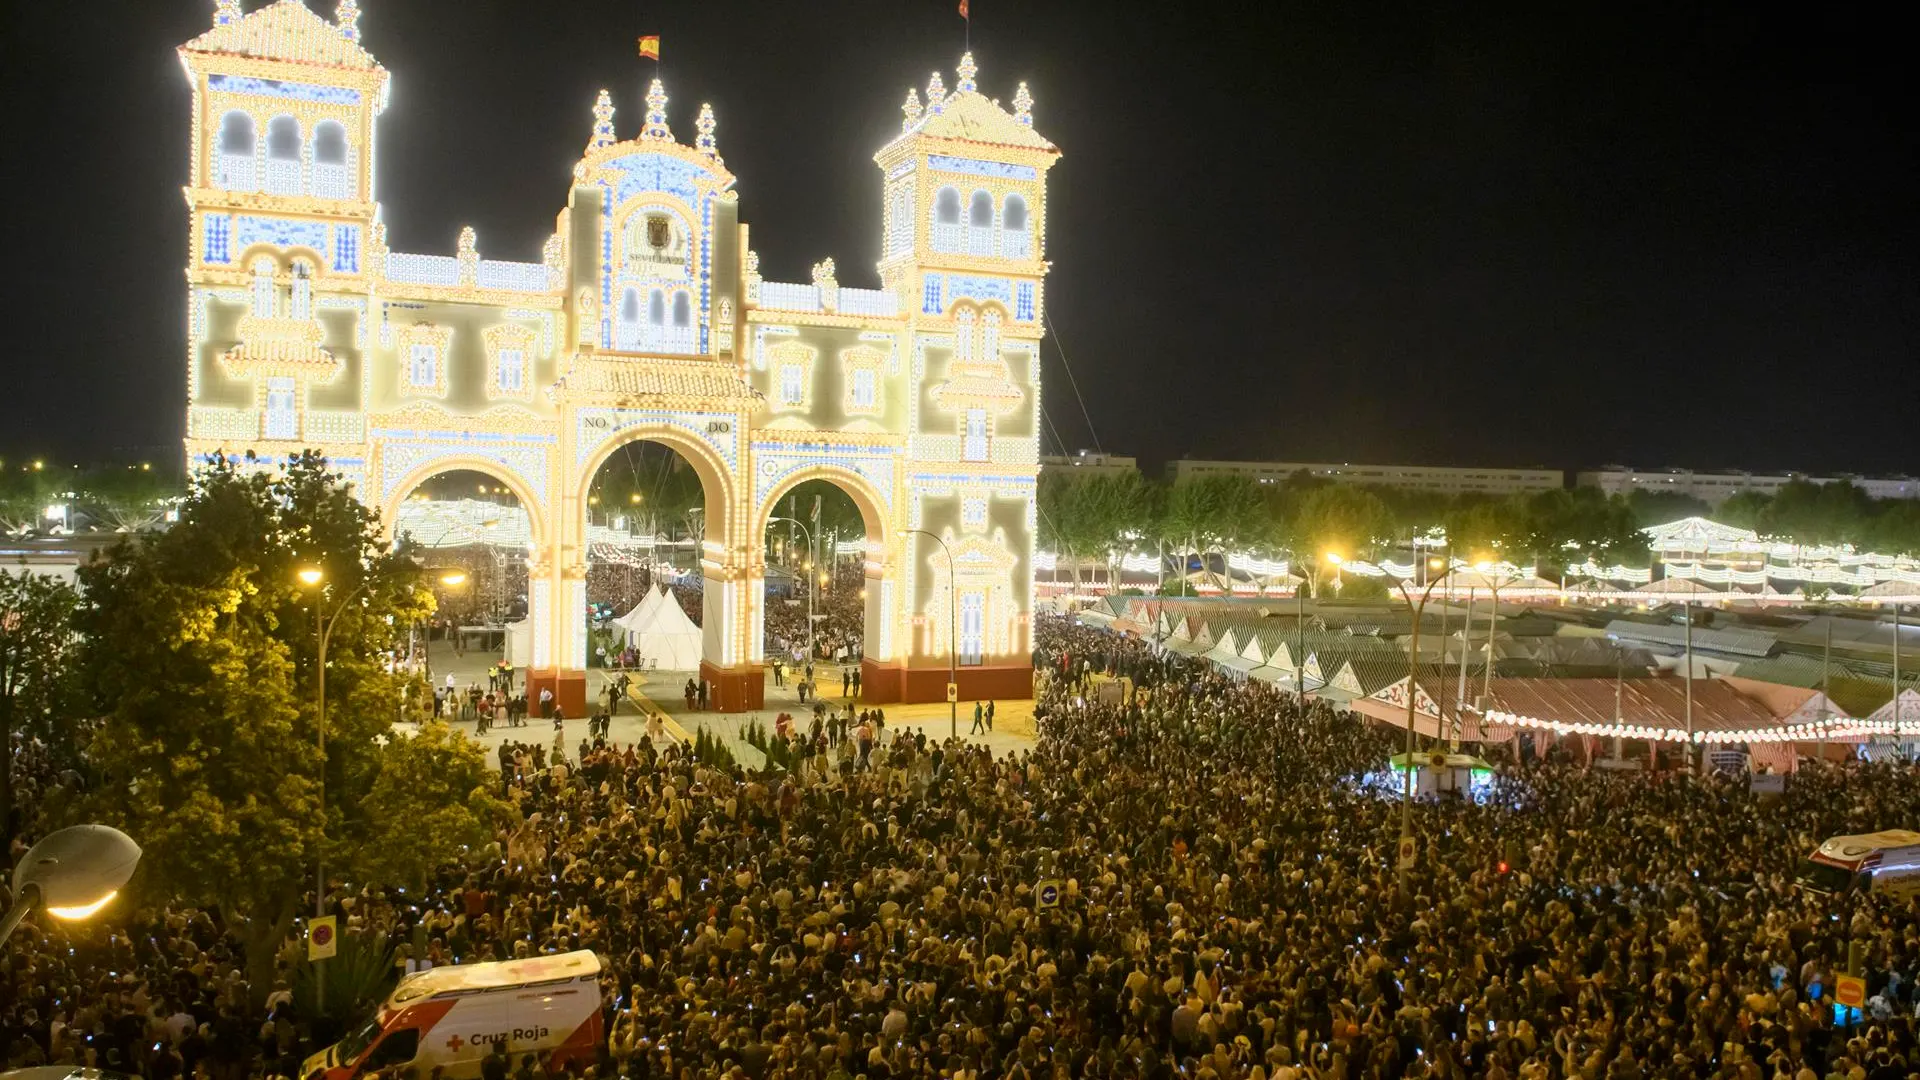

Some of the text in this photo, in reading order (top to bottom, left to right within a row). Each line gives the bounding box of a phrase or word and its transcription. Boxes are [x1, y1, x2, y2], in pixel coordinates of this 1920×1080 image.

[584, 417, 605, 429] NO
[708, 421, 729, 433] DO
[470, 1025, 549, 1046] Cruz Roja
